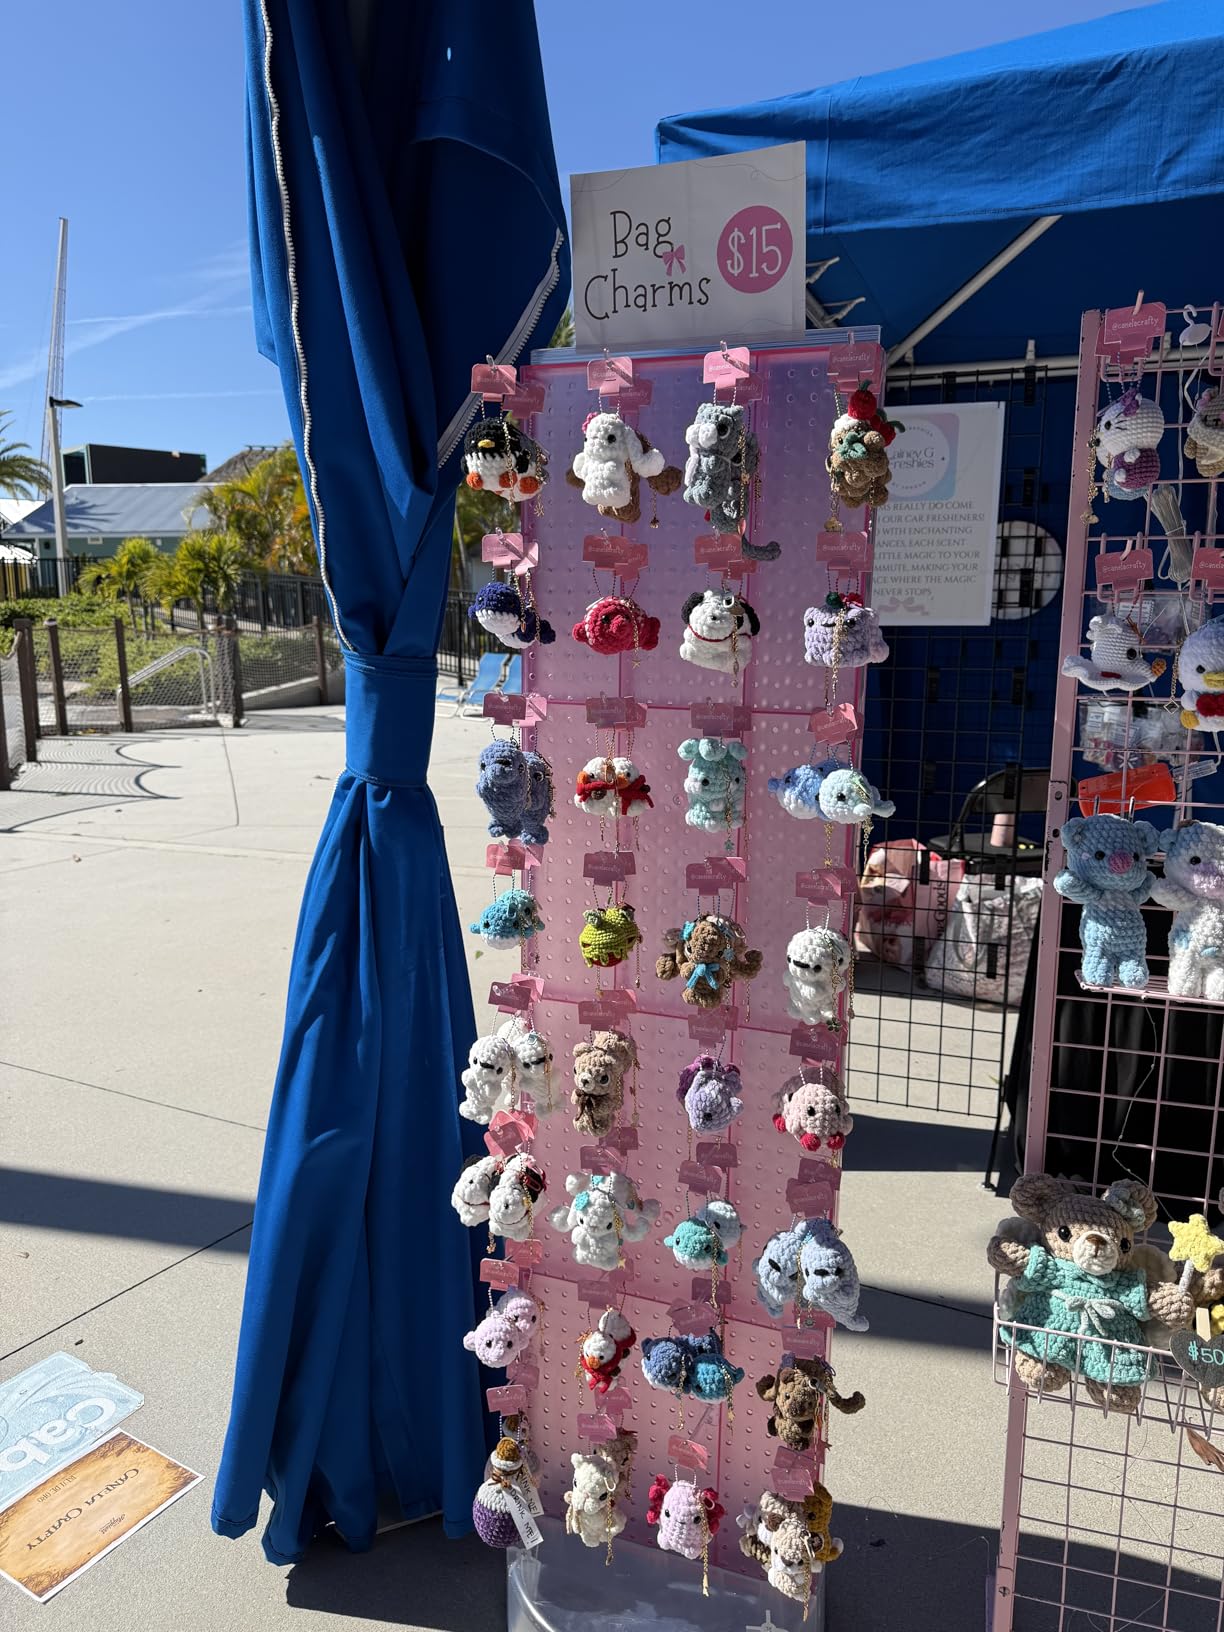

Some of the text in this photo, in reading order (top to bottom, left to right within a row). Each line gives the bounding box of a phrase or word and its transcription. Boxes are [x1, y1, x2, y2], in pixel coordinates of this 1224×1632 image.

[610, 210, 674, 258] Bag
[726, 222, 782, 277] $15
[585, 268, 711, 320] Charms
[945, 501, 973, 510] COME
[904, 514, 924, 522] CAR
[882, 526, 973, 536] WITH ENCHANTING
[908, 539, 934, 547] EACH
[936, 538, 966, 546] SCENT
[904, 551, 937, 560] MAGIC
[938, 551, 951, 559] TO
[951, 551, 980, 559] YOUR
[1102, 561, 1146, 574] @canelacrafty
[924, 575, 943, 584] THE
[944, 575, 976, 584] MAGIC
[1188, 1341, 1224, 1365] $50
[0, 1397, 116, 1472] Cab
[510, 1489, 526, 1520] DRINK
